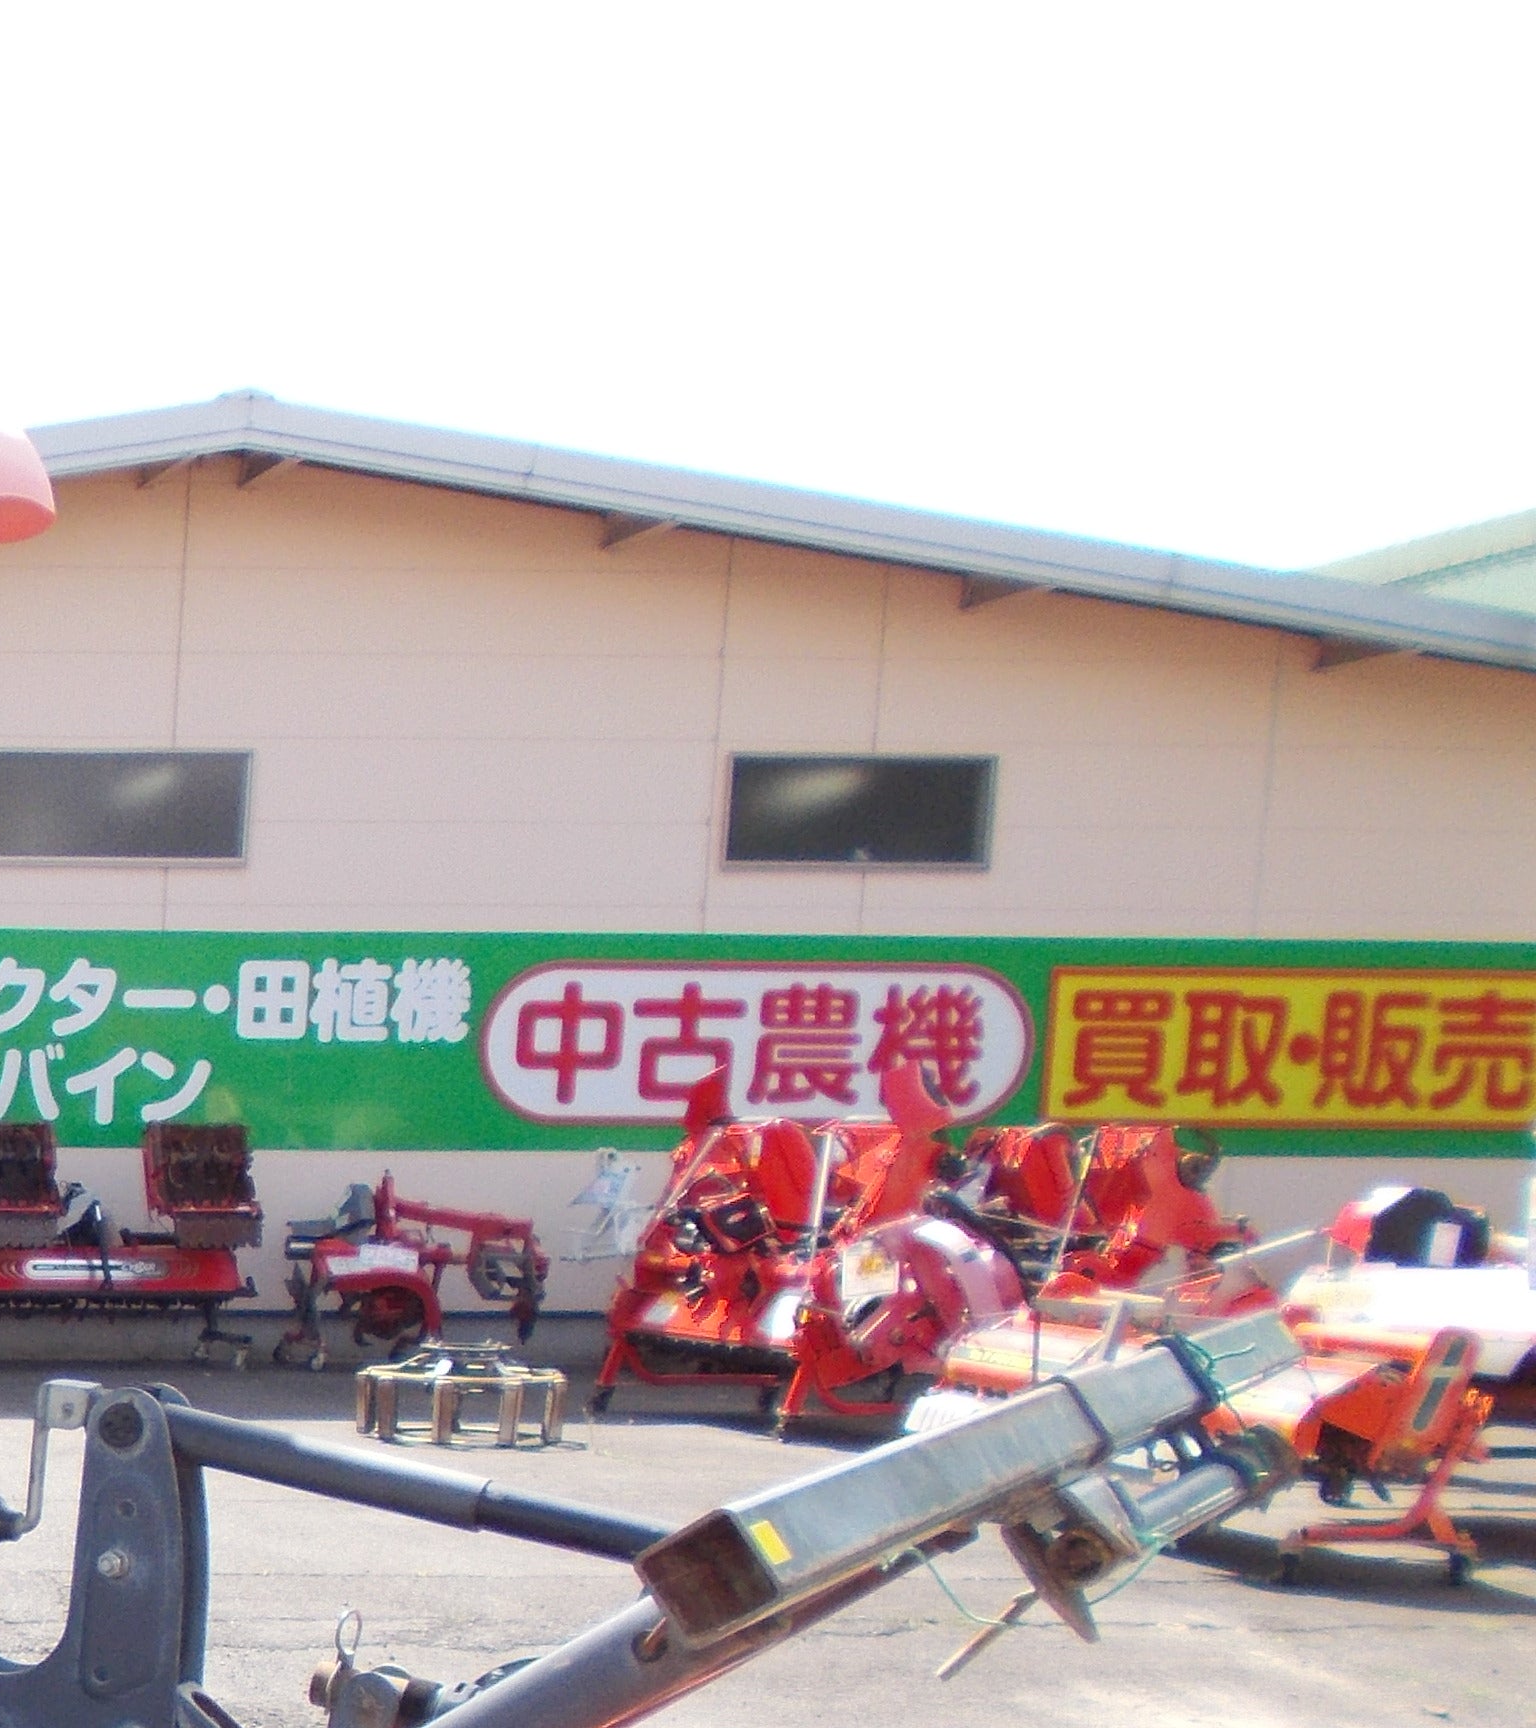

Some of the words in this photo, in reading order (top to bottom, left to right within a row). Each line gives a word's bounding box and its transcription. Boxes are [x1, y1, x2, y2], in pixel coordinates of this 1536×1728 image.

[516, 980, 984, 1106] 中古農機
[1063, 988, 1536, 1108] 買取・販売
